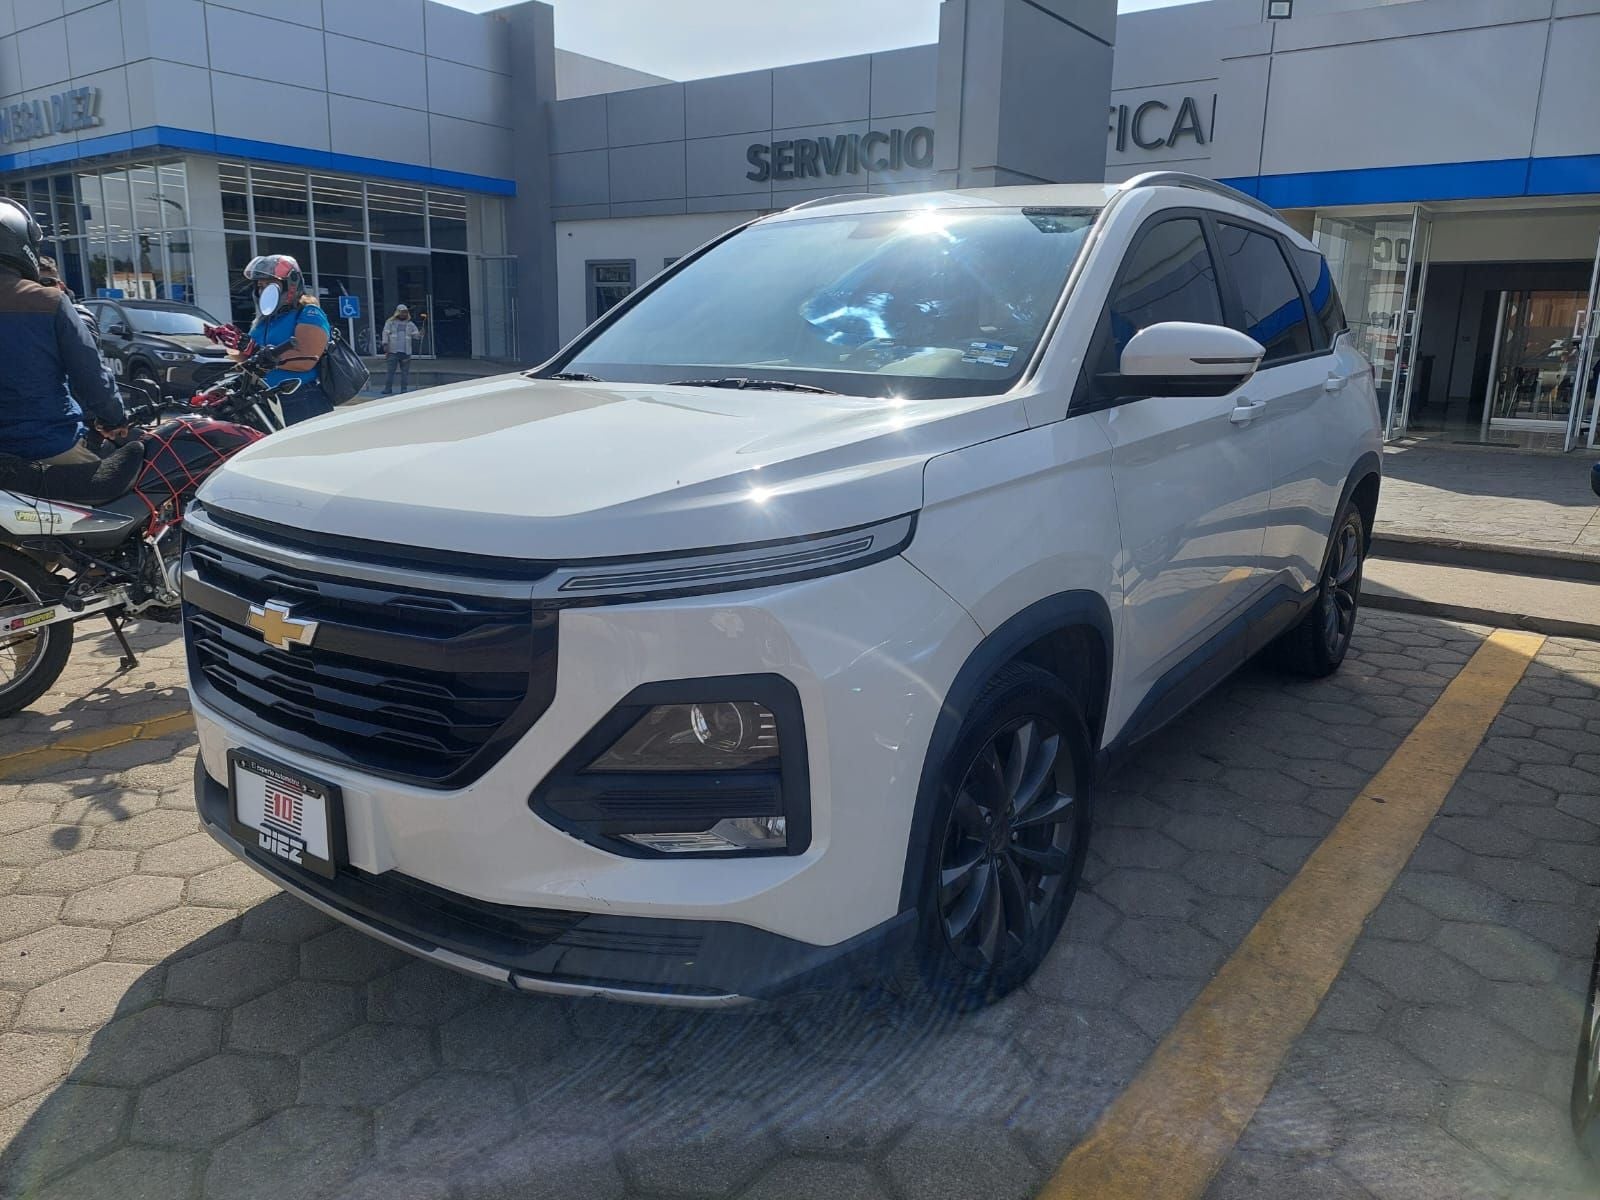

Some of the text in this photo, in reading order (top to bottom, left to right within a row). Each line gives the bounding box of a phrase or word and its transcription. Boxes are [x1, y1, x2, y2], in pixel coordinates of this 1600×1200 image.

[50, 86, 104, 134] DIEZ
[1107, 96, 1206, 153] ICA
[746, 126, 935, 182] SERVICIO
[274, 793, 293, 822] 10
[258, 826, 303, 865] DIEZ
